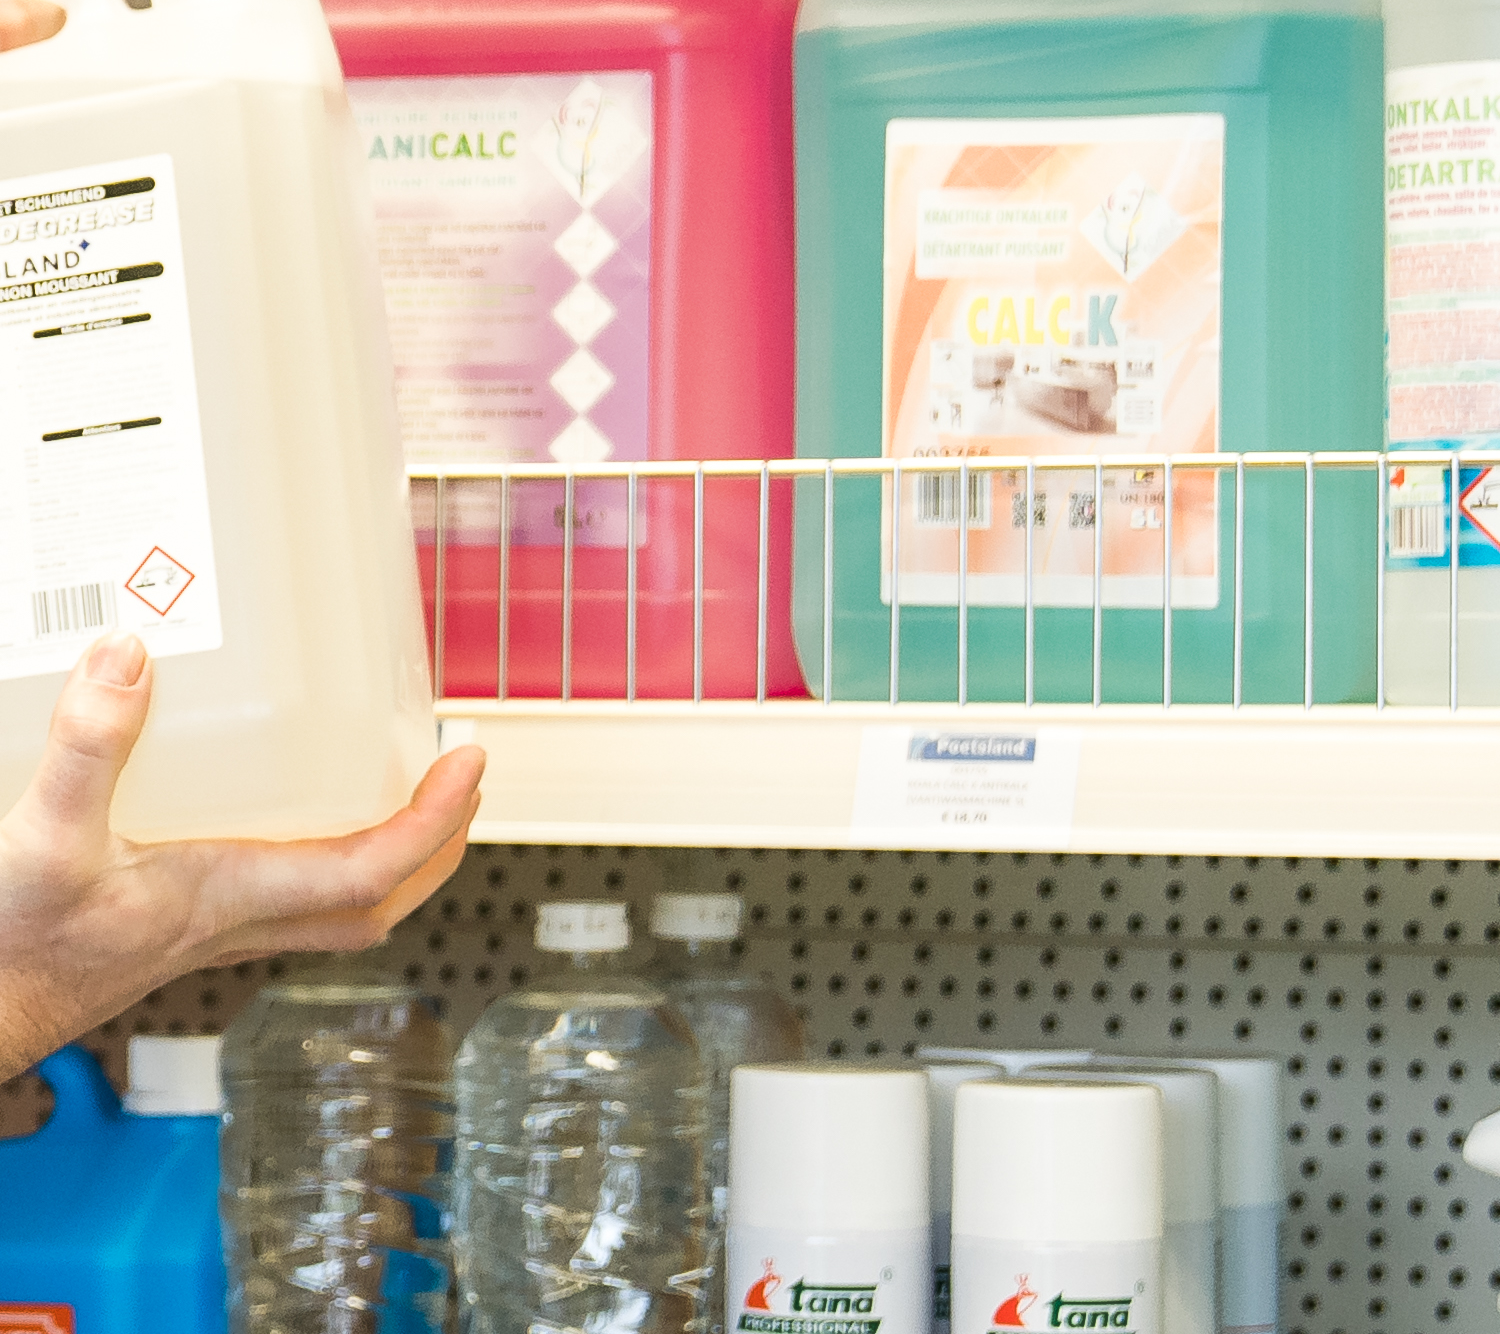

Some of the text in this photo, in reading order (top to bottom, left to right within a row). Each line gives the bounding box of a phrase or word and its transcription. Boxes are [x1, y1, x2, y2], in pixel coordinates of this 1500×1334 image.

[368, 131, 517, 160] ANICALC
[15, 186, 106, 214] SCHUIMEND
[0, 282, 33, 302] NON
[35, 269, 119, 297] MOUSSANT
[968, 295, 1119, 347] CALC K
[937, 738, 1026, 756] Poetsland
[788, 1275, 878, 1314] tana
[1045, 1291, 1133, 1328] tana
[744, 1316, 872, 1334] PROFESSIONAL
